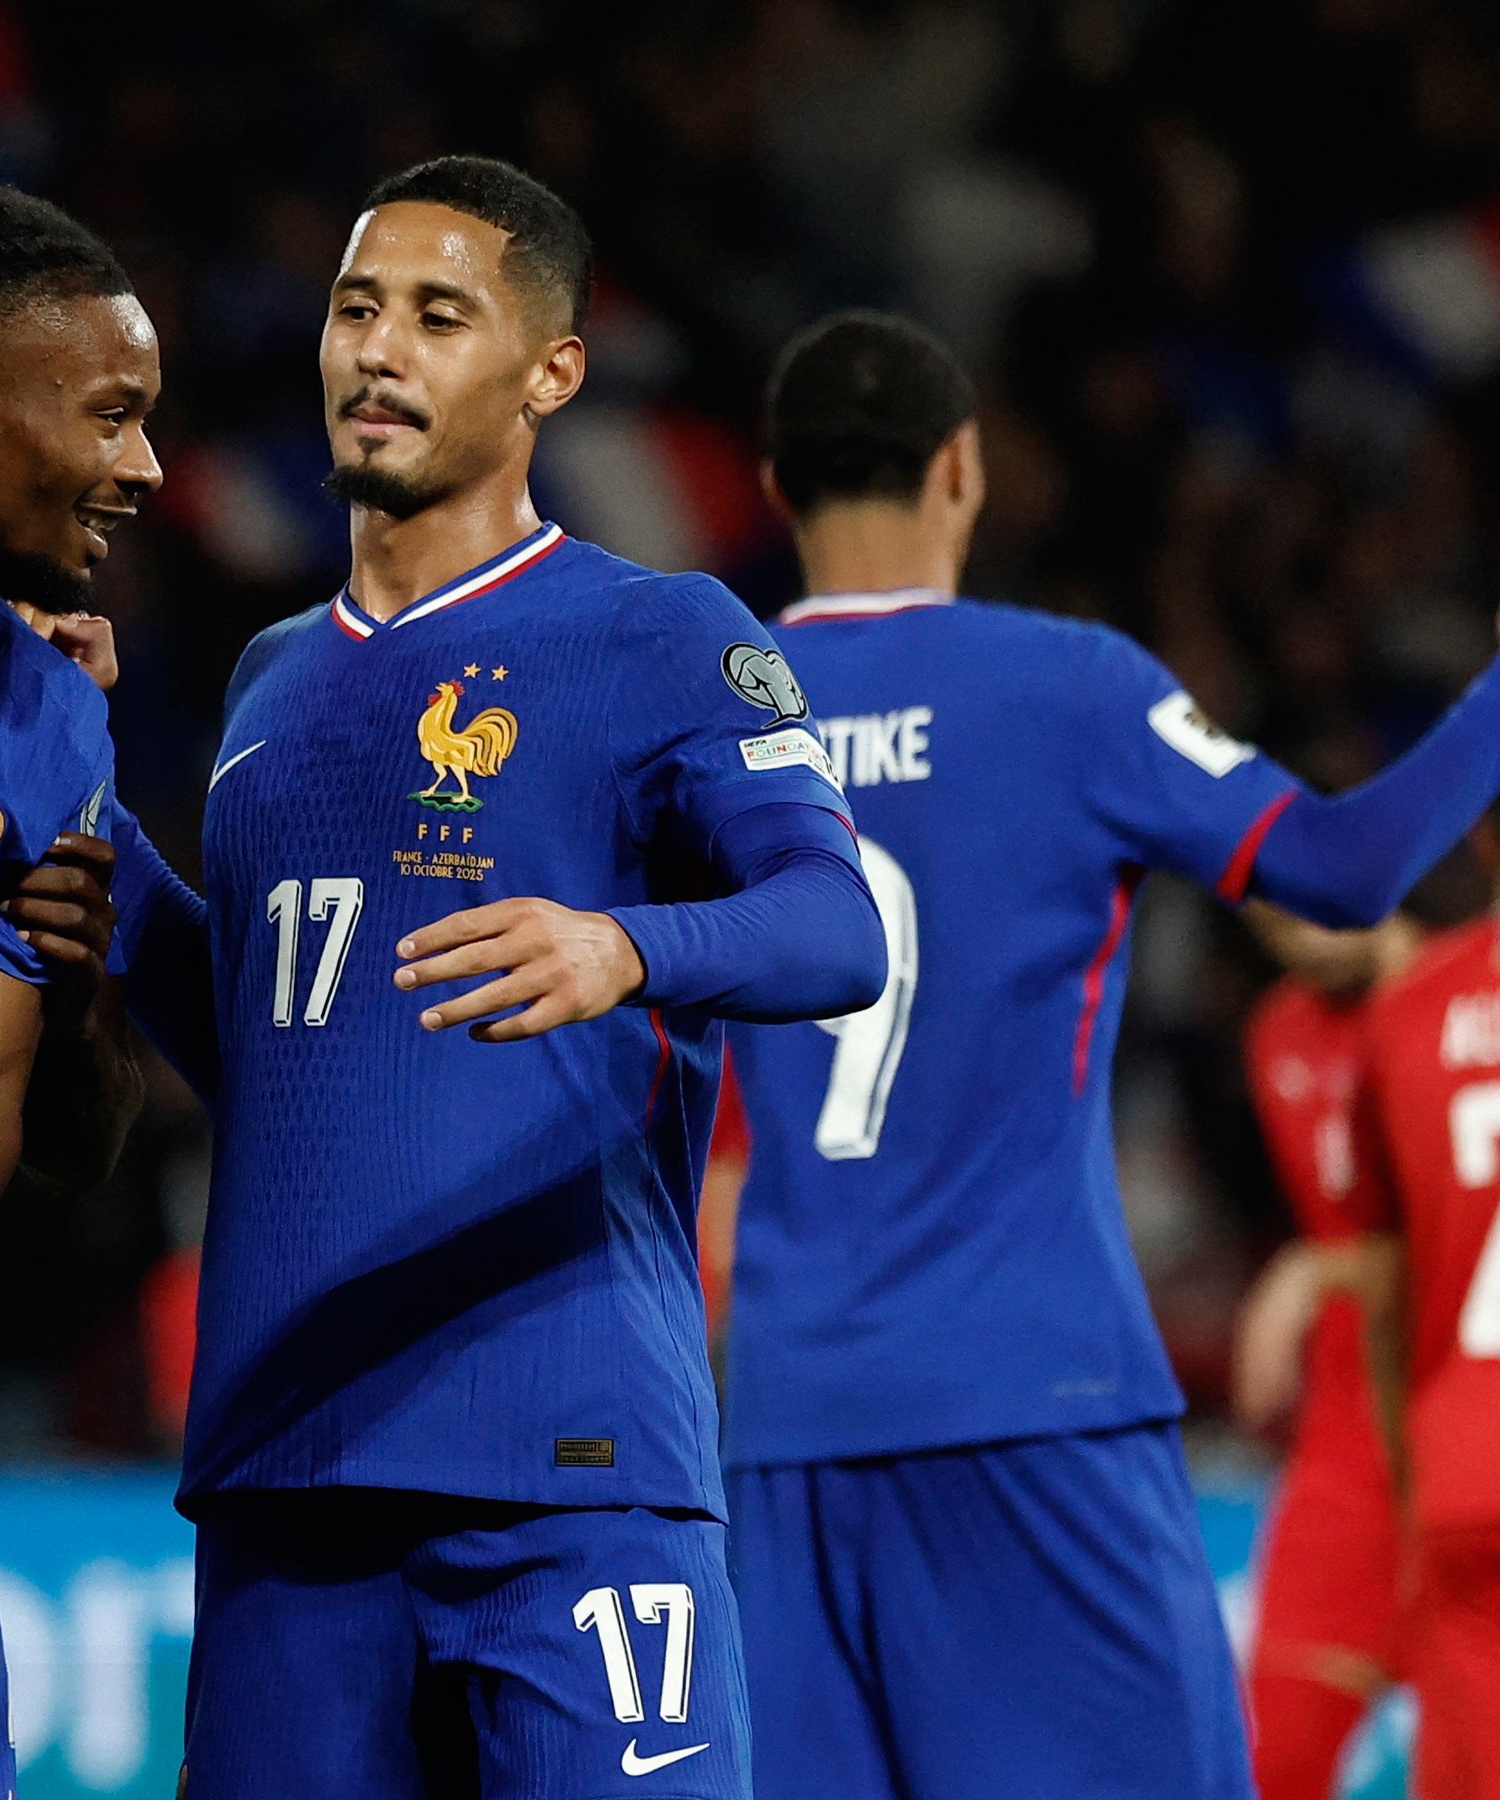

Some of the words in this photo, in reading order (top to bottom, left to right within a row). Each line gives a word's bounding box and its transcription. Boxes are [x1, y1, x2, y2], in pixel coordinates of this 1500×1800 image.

[744, 740, 767, 748] UEFA
[817, 705, 934, 788] TIKE
[393, 850, 423, 862] FRANCE
[432, 852, 494, 869] AZERBAÏDJAN
[401, 863, 411, 876] 10
[414, 864, 453, 878] OCTOBRE
[456, 868, 484, 881] 2025
[267, 877, 364, 1028] 17
[572, 1583, 696, 1723] 17
